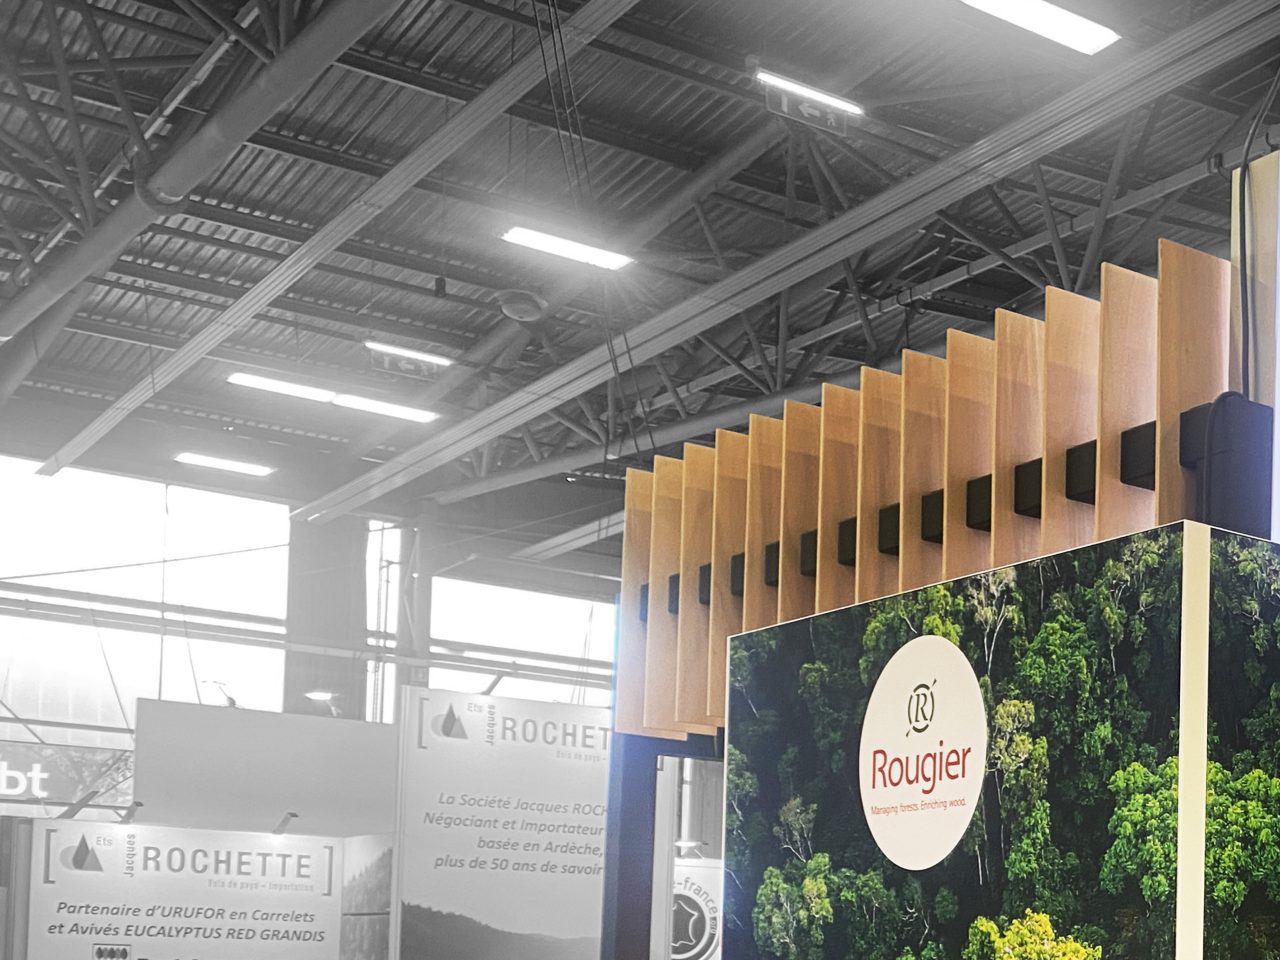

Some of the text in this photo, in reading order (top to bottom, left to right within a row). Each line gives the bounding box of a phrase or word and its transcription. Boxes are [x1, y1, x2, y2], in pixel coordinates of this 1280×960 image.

[485, 704, 496, 747] Jacques
[871, 740, 972, 795] Rougier
[438, 792, 456, 805] La
[458, 793, 511, 810] Société
[513, 798, 569, 816] Jacques
[423, 811, 499, 830] Négociant
[502, 819, 516, 831] et
[96, 836, 113, 847] Ets
[476, 836, 520, 851] basée
[523, 842, 540, 853] en
[123, 833, 136, 878] Jacques
[142, 845, 312, 879] ROCHETTE
[434, 855, 465, 870] plus
[468, 857, 487, 870] de
[490, 858, 509, 871] 50
[511, 861, 537, 872] ans
[540, 861, 558, 874] de
[56, 901, 142, 917] Partenaire
[229, 909, 248, 921] en
[251, 908, 316, 924] Carrelets
[47, 921, 326, 943] et Avivés EUCALYPTUS RED GRANDIS
